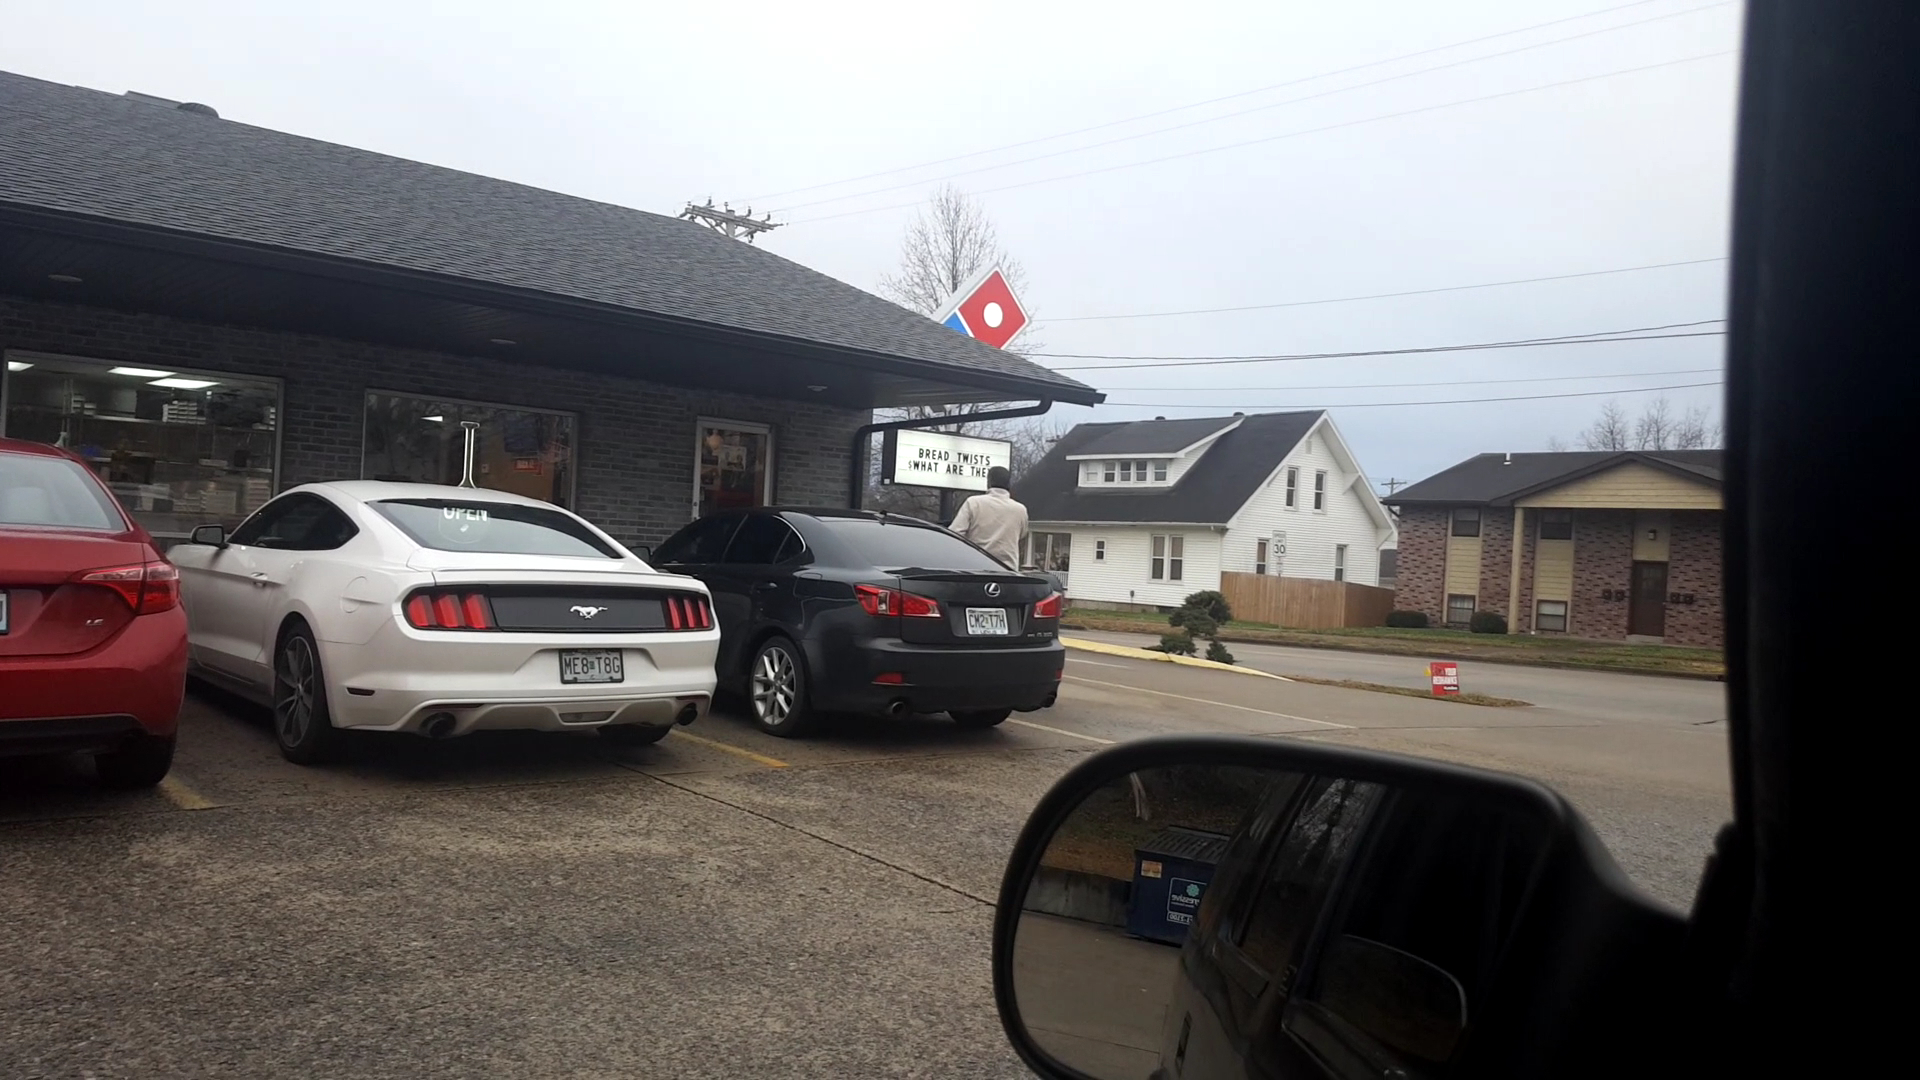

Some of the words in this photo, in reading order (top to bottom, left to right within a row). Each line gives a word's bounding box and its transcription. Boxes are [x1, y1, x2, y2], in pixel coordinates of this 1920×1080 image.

[918, 447, 950, 462] BREAD
[957, 452, 991, 466] TWISTS
[945, 464, 964, 476] ARE
[971, 466, 989, 478] THE
[1274, 544, 1286, 554] 30
[563, 656, 589, 676] ME8
[594, 655, 621, 675] T8G
